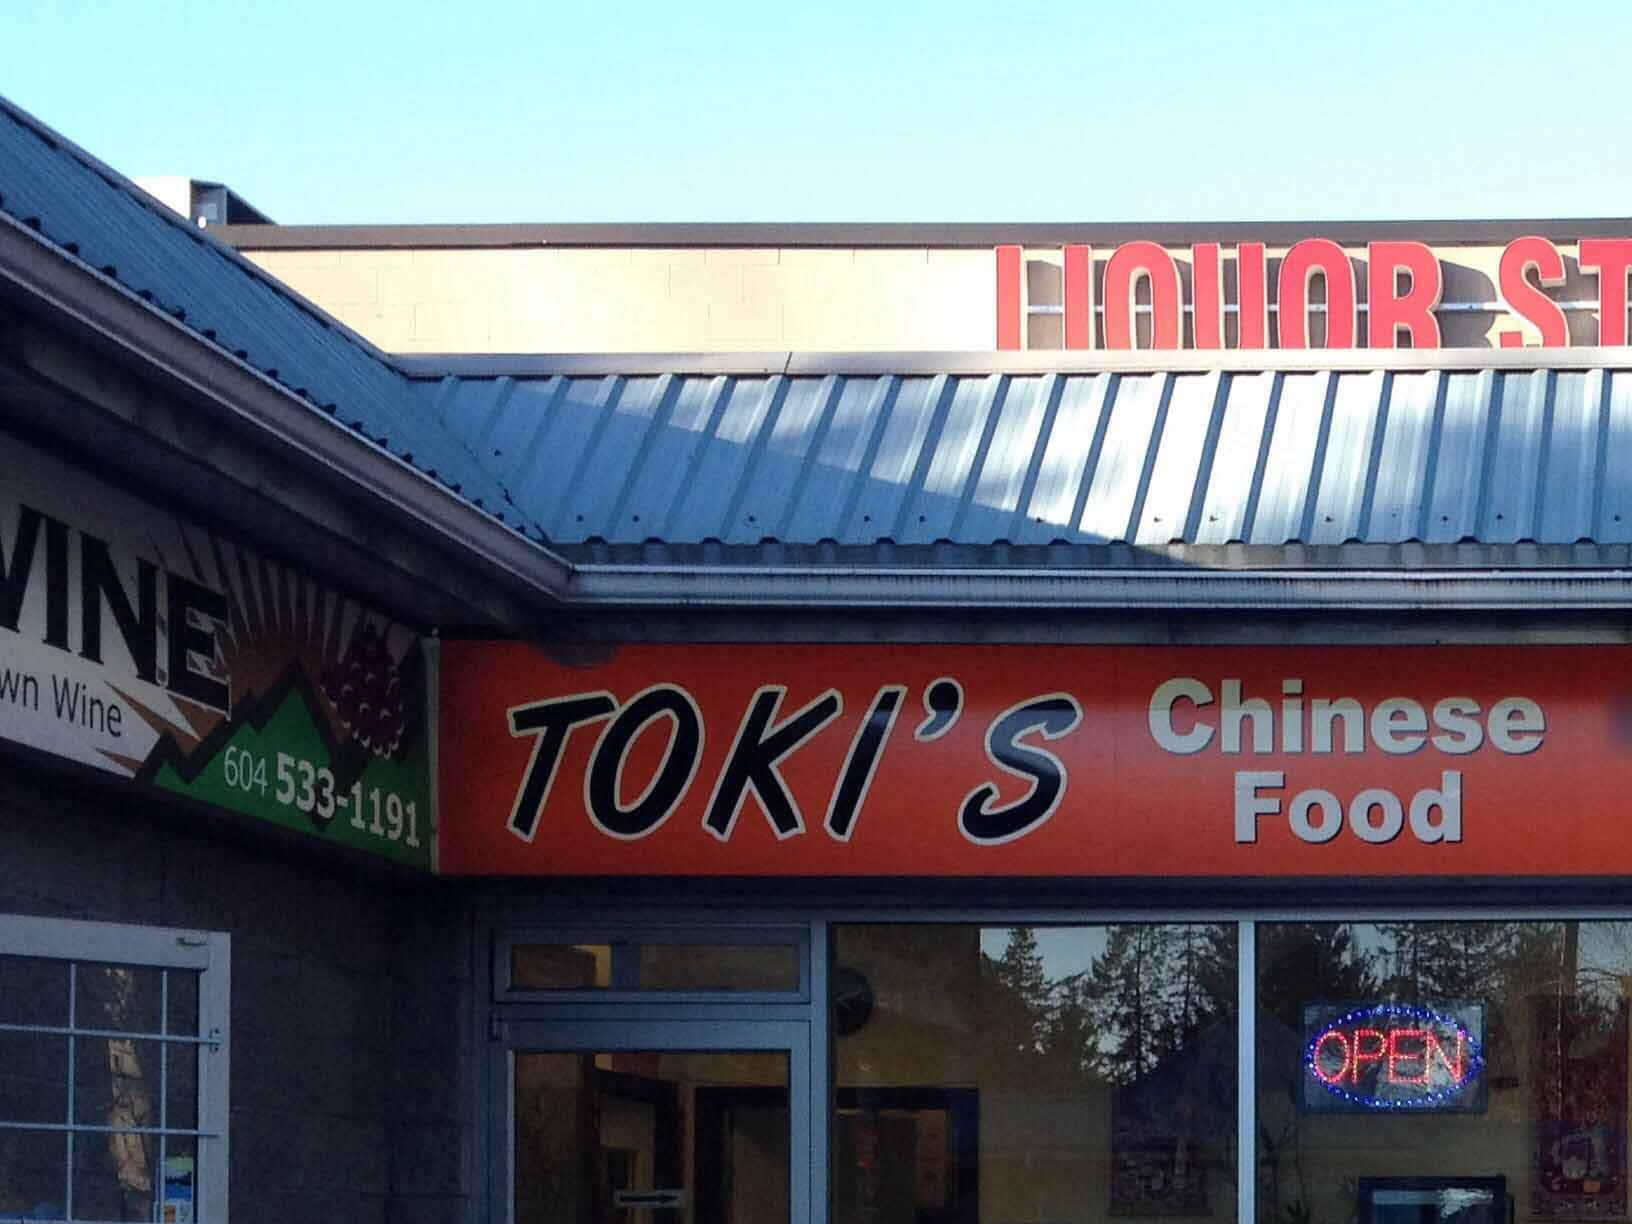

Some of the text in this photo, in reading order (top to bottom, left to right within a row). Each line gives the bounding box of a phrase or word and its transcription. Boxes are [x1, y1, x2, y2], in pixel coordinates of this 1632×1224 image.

[52, 673, 122, 738] Wine
[1147, 677, 1547, 755] Chinese
[224, 746, 420, 848] 604 533-1191
[507, 677, 1084, 846] TOKI'S
[1233, 771, 1465, 845] Food
[1314, 1028, 1467, 1085] OPEN
